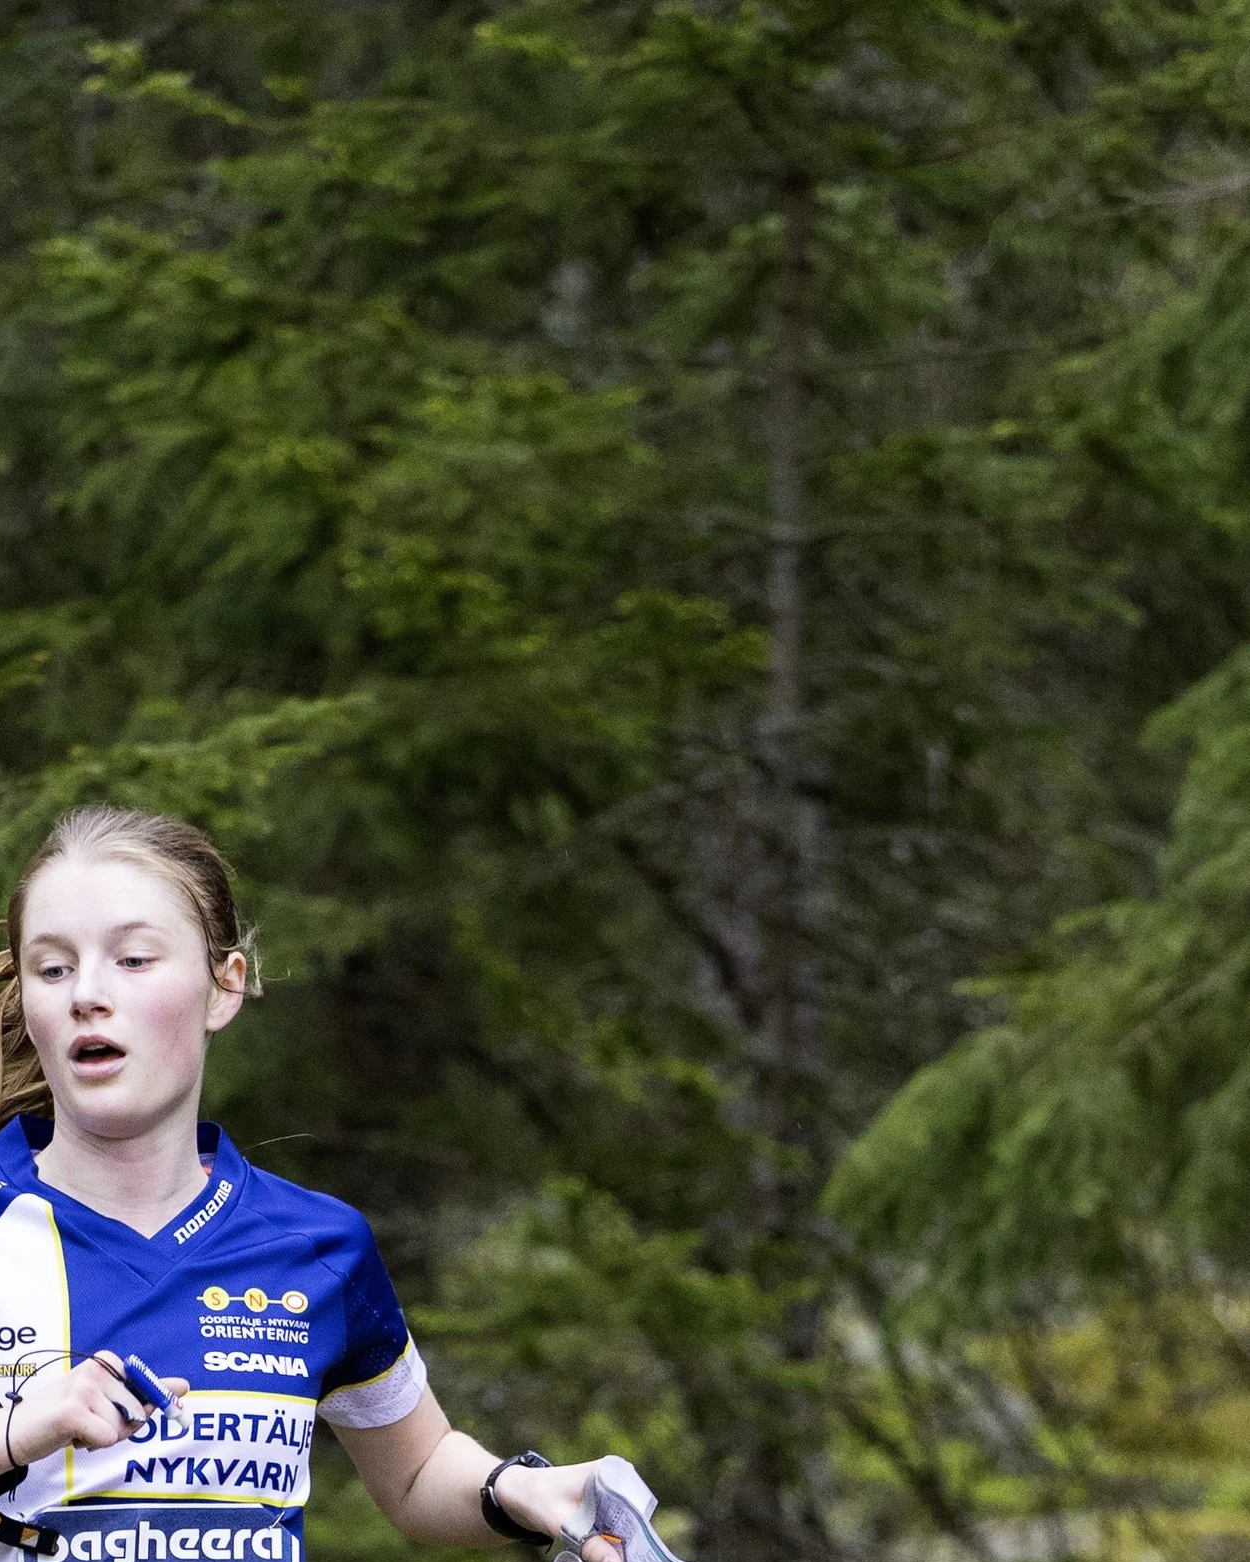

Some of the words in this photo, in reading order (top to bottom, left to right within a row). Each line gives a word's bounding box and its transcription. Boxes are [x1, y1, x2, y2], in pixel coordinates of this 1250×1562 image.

[173, 1180, 233, 1245] noname
[200, 1325, 309, 1344] ORIENTERING
[203, 1351, 309, 1378] SCANIA
[128, 1409, 313, 1455] DERTÄLJE
[124, 1457, 299, 1493] NYKVARN
